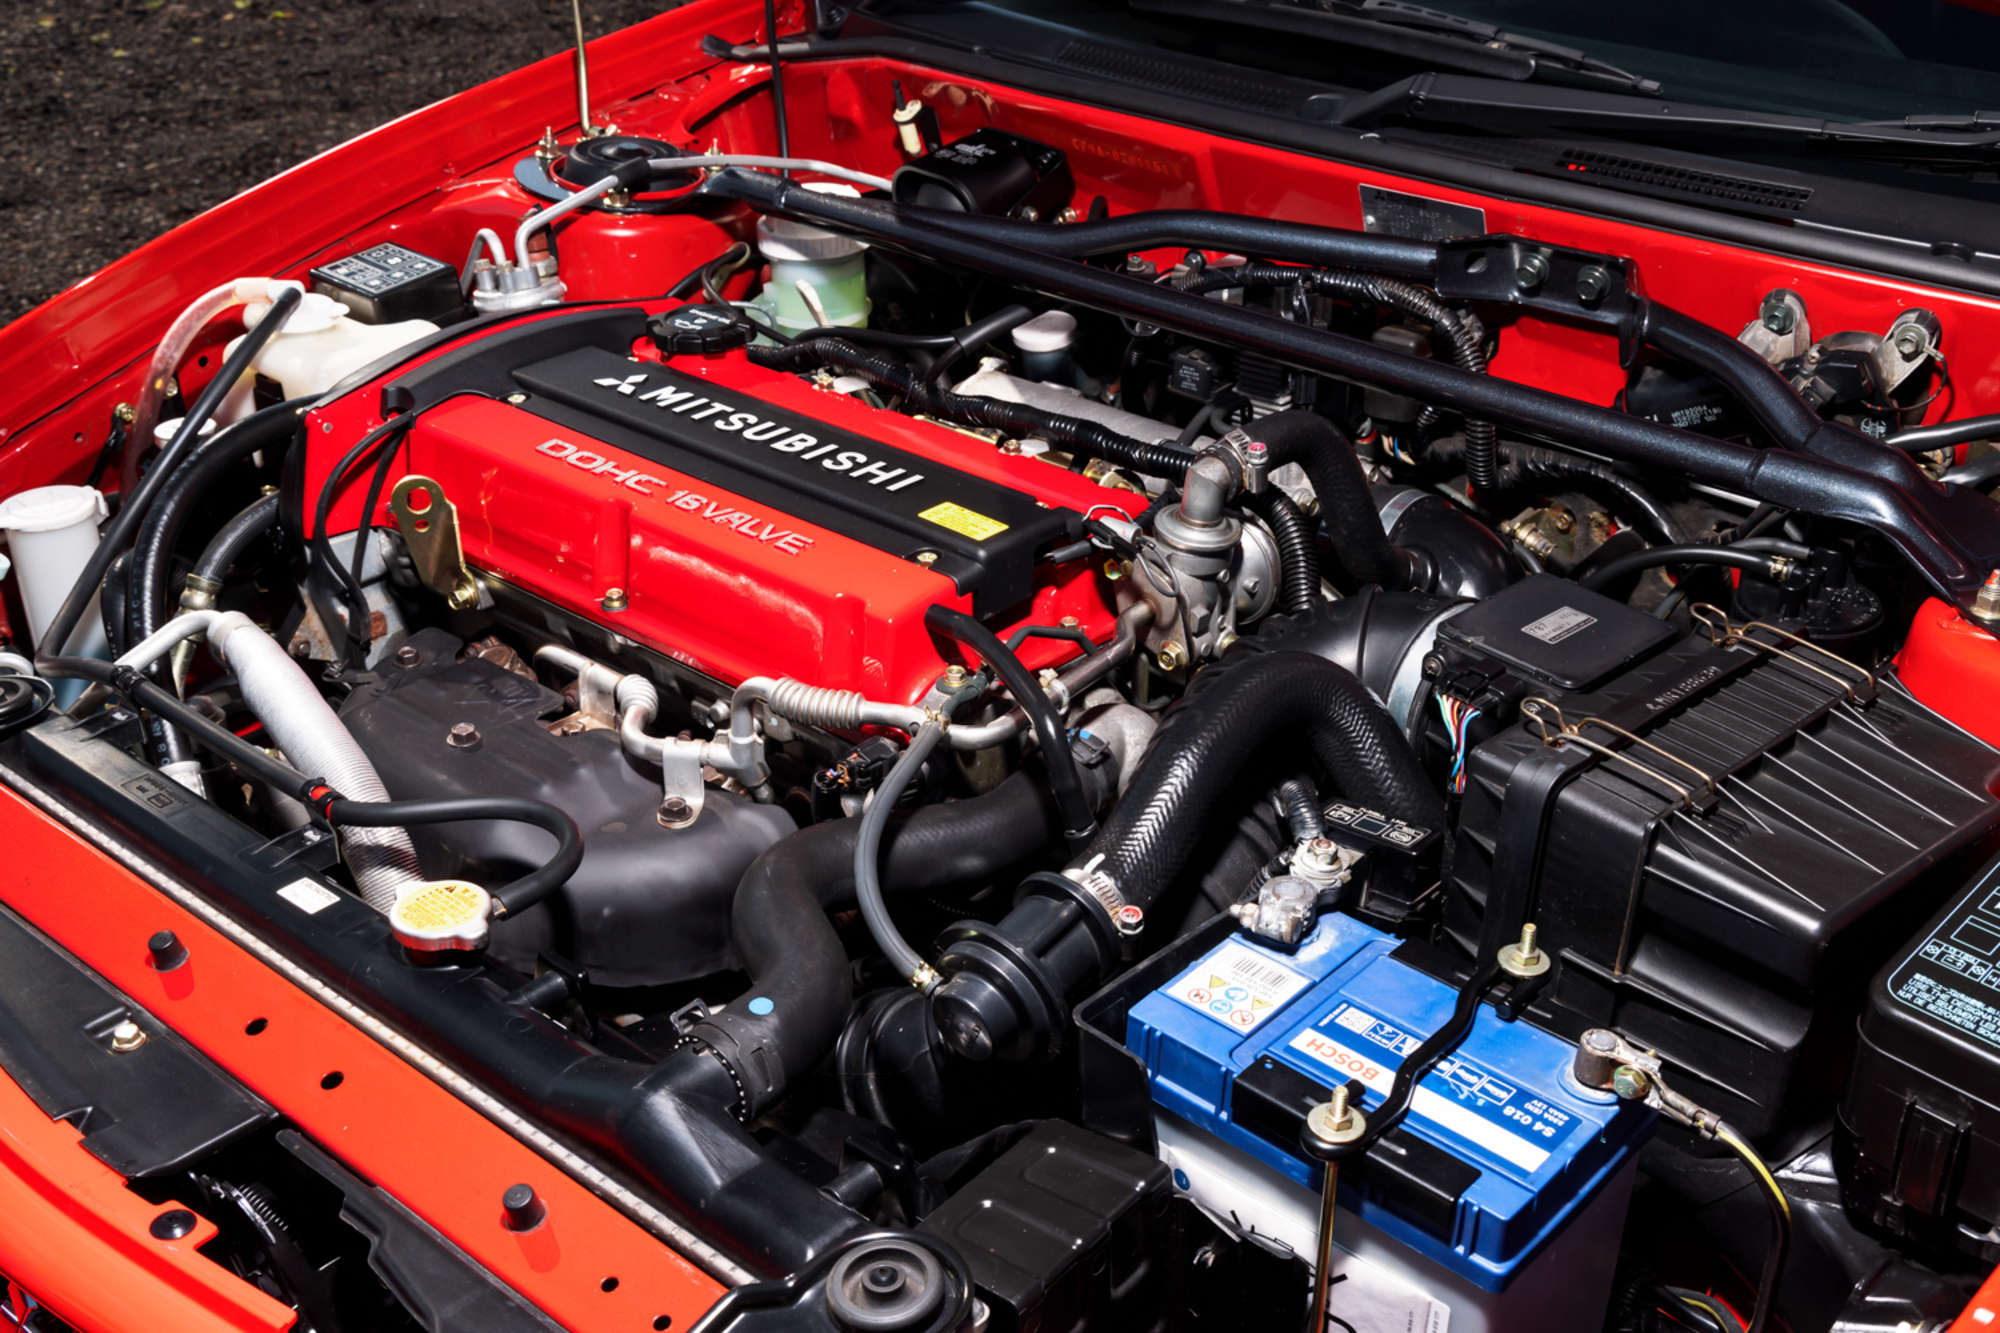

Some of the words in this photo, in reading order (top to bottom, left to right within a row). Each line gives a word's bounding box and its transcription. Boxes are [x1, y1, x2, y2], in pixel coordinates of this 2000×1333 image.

[639, 385, 925, 493] MITSUBISHI
[536, 438, 667, 494] DOHC
[1305, 1037, 1381, 1081] BOSCH
[1503, 1105, 1533, 1125] 018
[1532, 1121, 1556, 1138] S4
